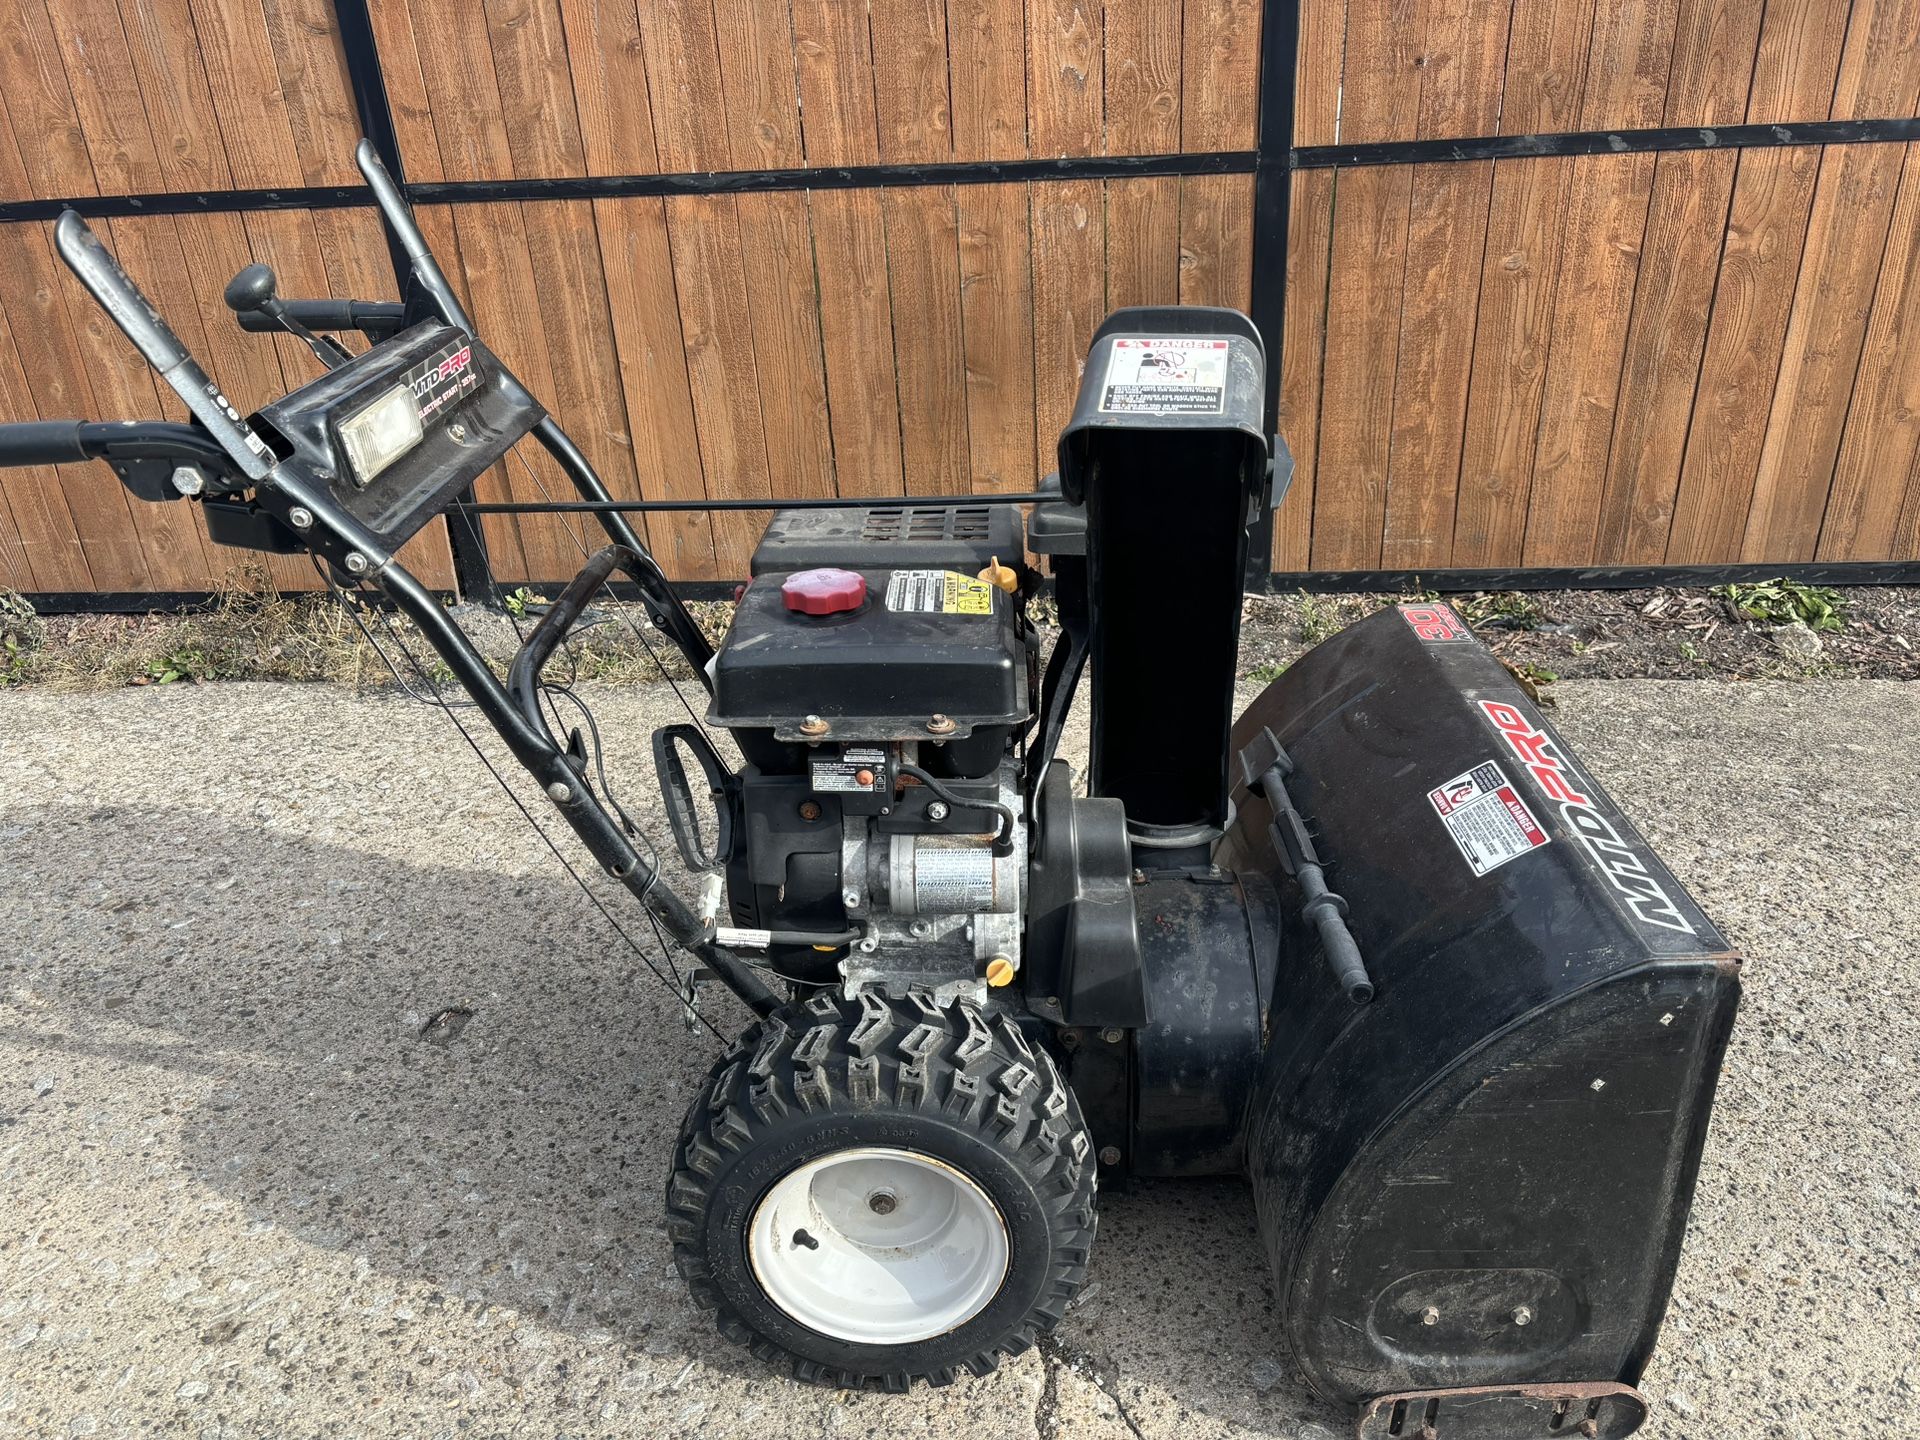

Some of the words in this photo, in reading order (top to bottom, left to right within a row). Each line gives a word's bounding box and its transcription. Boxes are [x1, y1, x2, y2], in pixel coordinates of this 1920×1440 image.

[1150, 341, 1213, 349] DANGER
[418, 396, 443, 419] ELECTRIC
[442, 384, 459, 401] START
[1478, 699, 1697, 936] MTDPRO
[1511, 802, 1536, 833] DANGER
